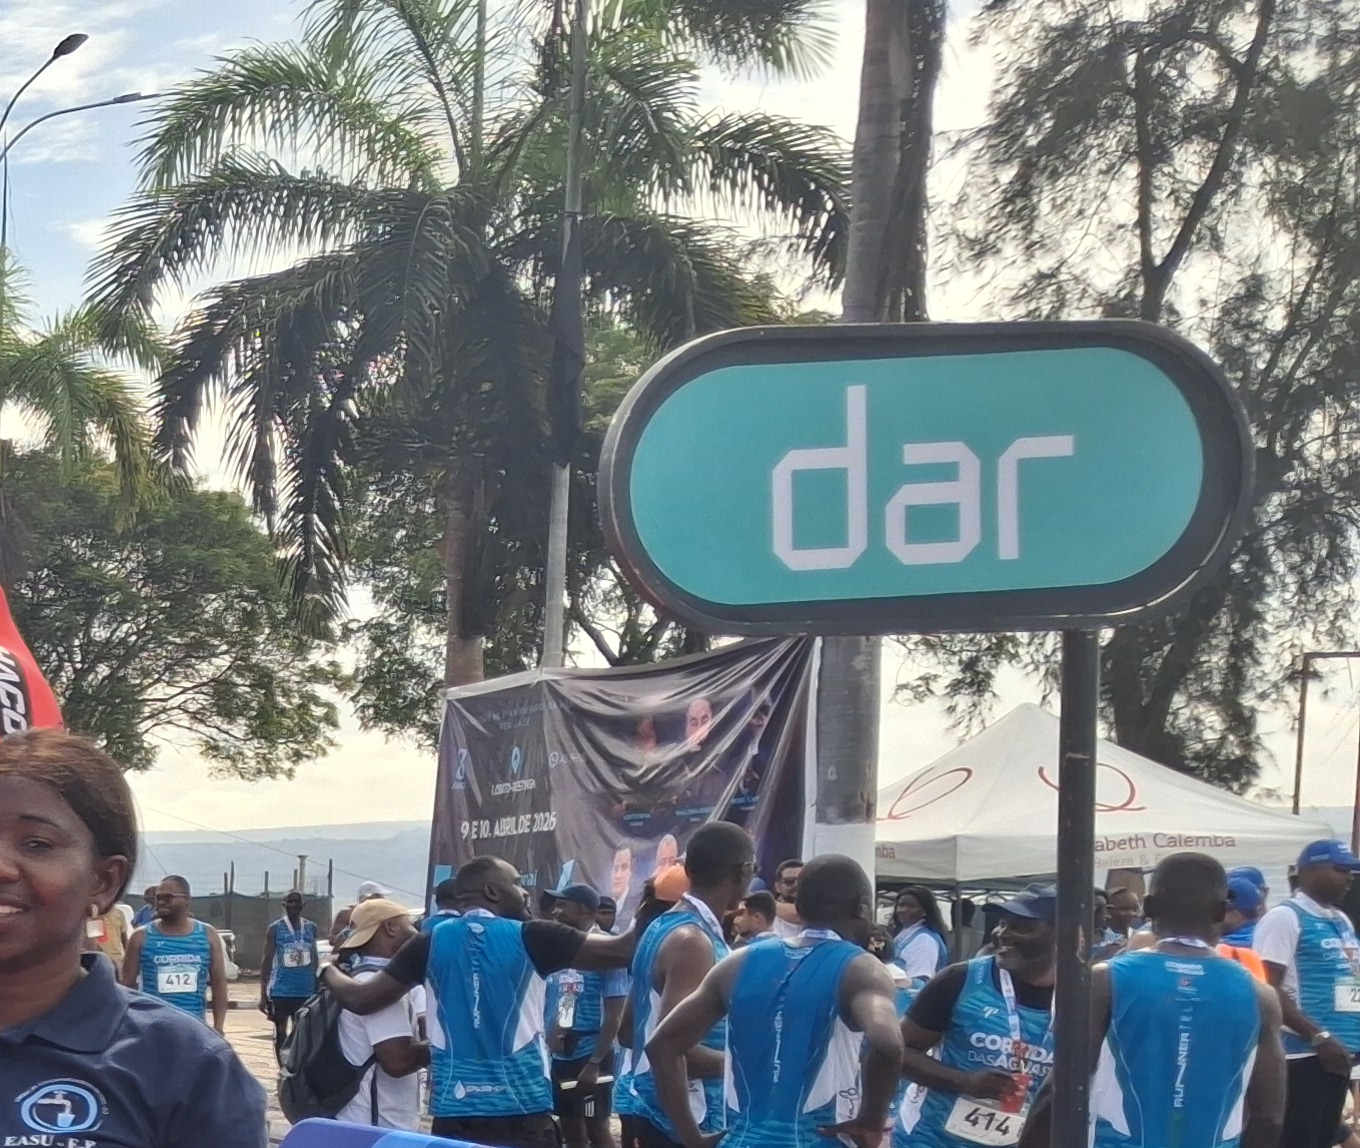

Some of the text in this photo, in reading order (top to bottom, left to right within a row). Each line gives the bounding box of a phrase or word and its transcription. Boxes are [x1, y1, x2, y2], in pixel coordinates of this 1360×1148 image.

[771, 384, 1075, 573] dar
[1152, 832, 1237, 851] Calemba
[166, 973, 192, 986] 412
[964, 1107, 1011, 1136] 414
[3, 1135, 55, 1147] EASU
